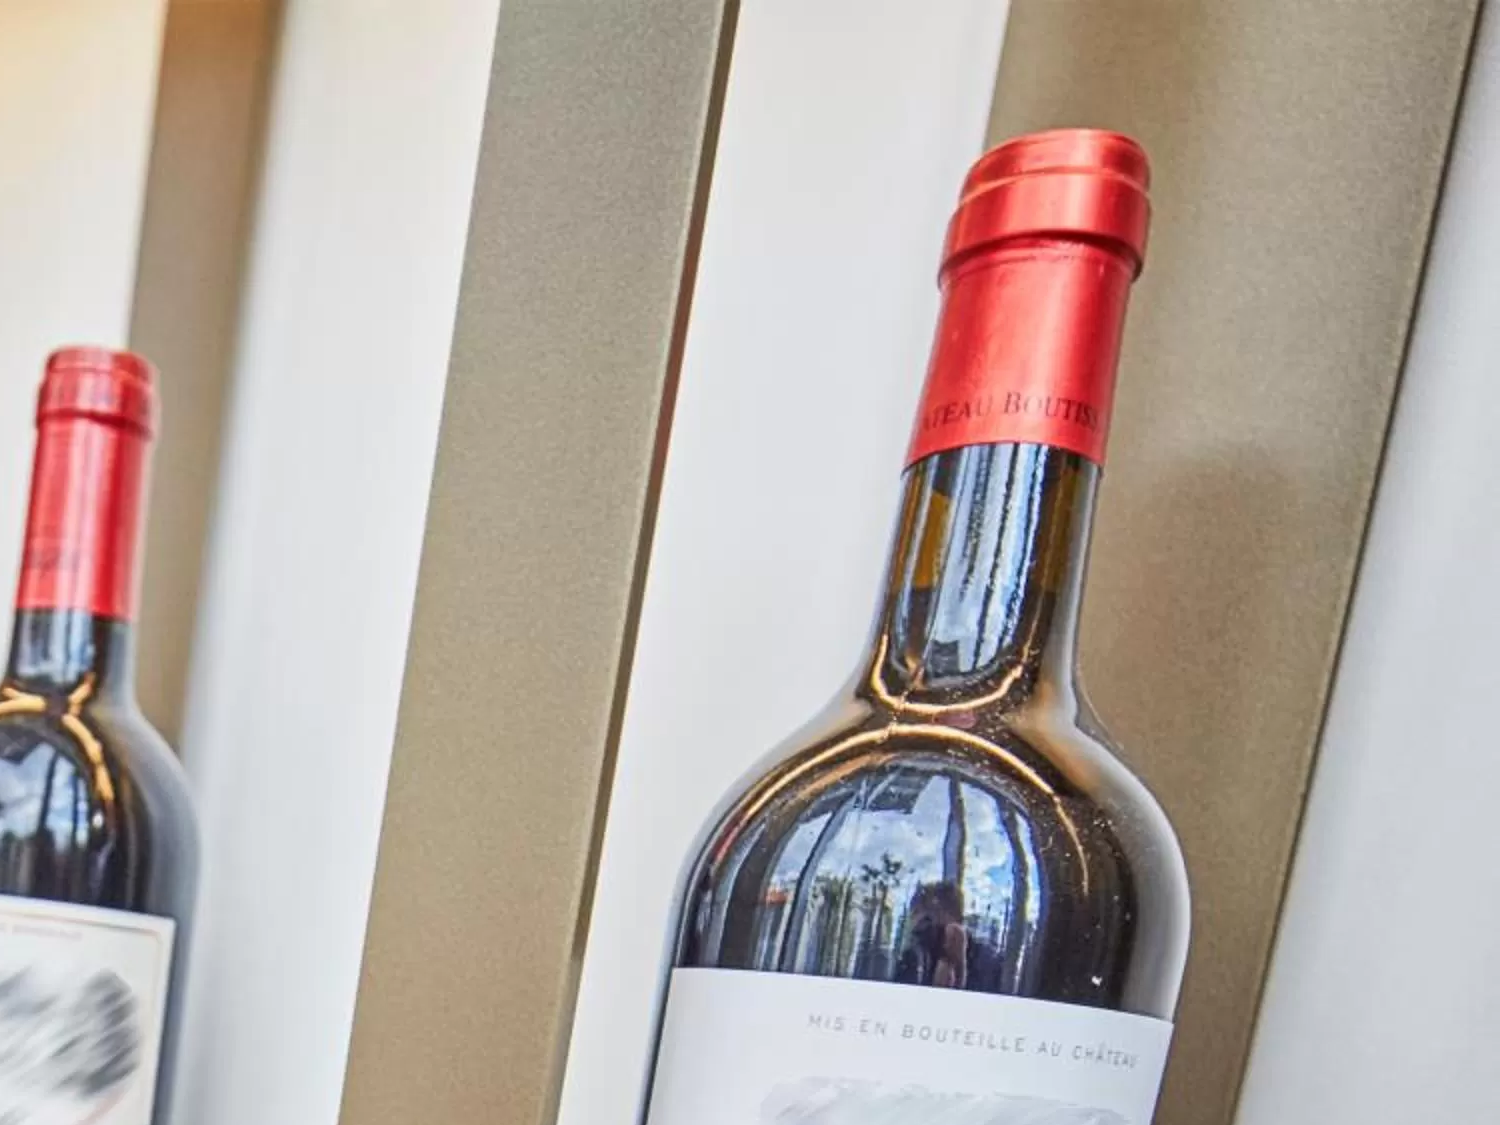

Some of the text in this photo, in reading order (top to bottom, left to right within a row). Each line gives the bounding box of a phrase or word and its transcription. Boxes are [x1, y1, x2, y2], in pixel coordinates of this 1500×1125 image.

[808, 1014, 845, 1032] MIS
[860, 1018, 887, 1037] EN
[902, 1024, 1026, 1053] BOUTEILLE
[1037, 1041, 1063, 1058] AU
